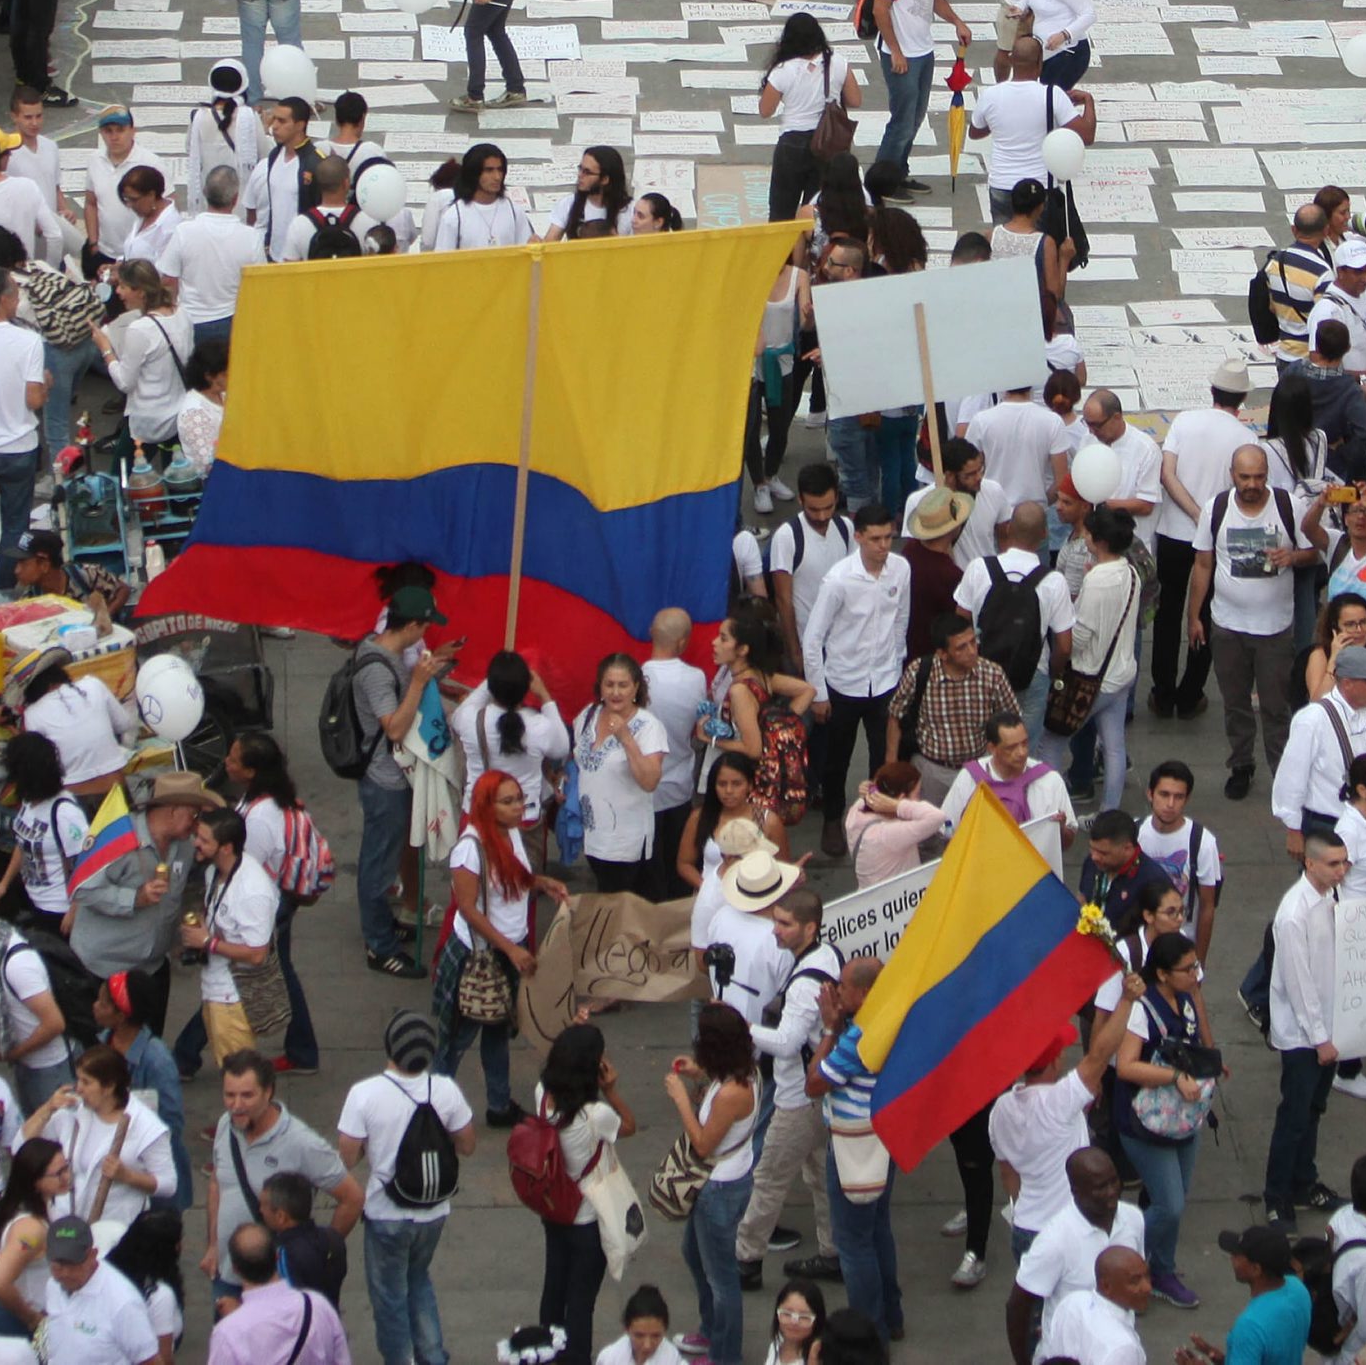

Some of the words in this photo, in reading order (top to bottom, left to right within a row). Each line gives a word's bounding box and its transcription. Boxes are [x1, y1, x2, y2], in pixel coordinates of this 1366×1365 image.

[135, 615, 185, 644] COPITO
[187, 613, 203, 629] DE
[817, 907, 877, 944] Felices
[1341, 995, 1362, 1012] LO
